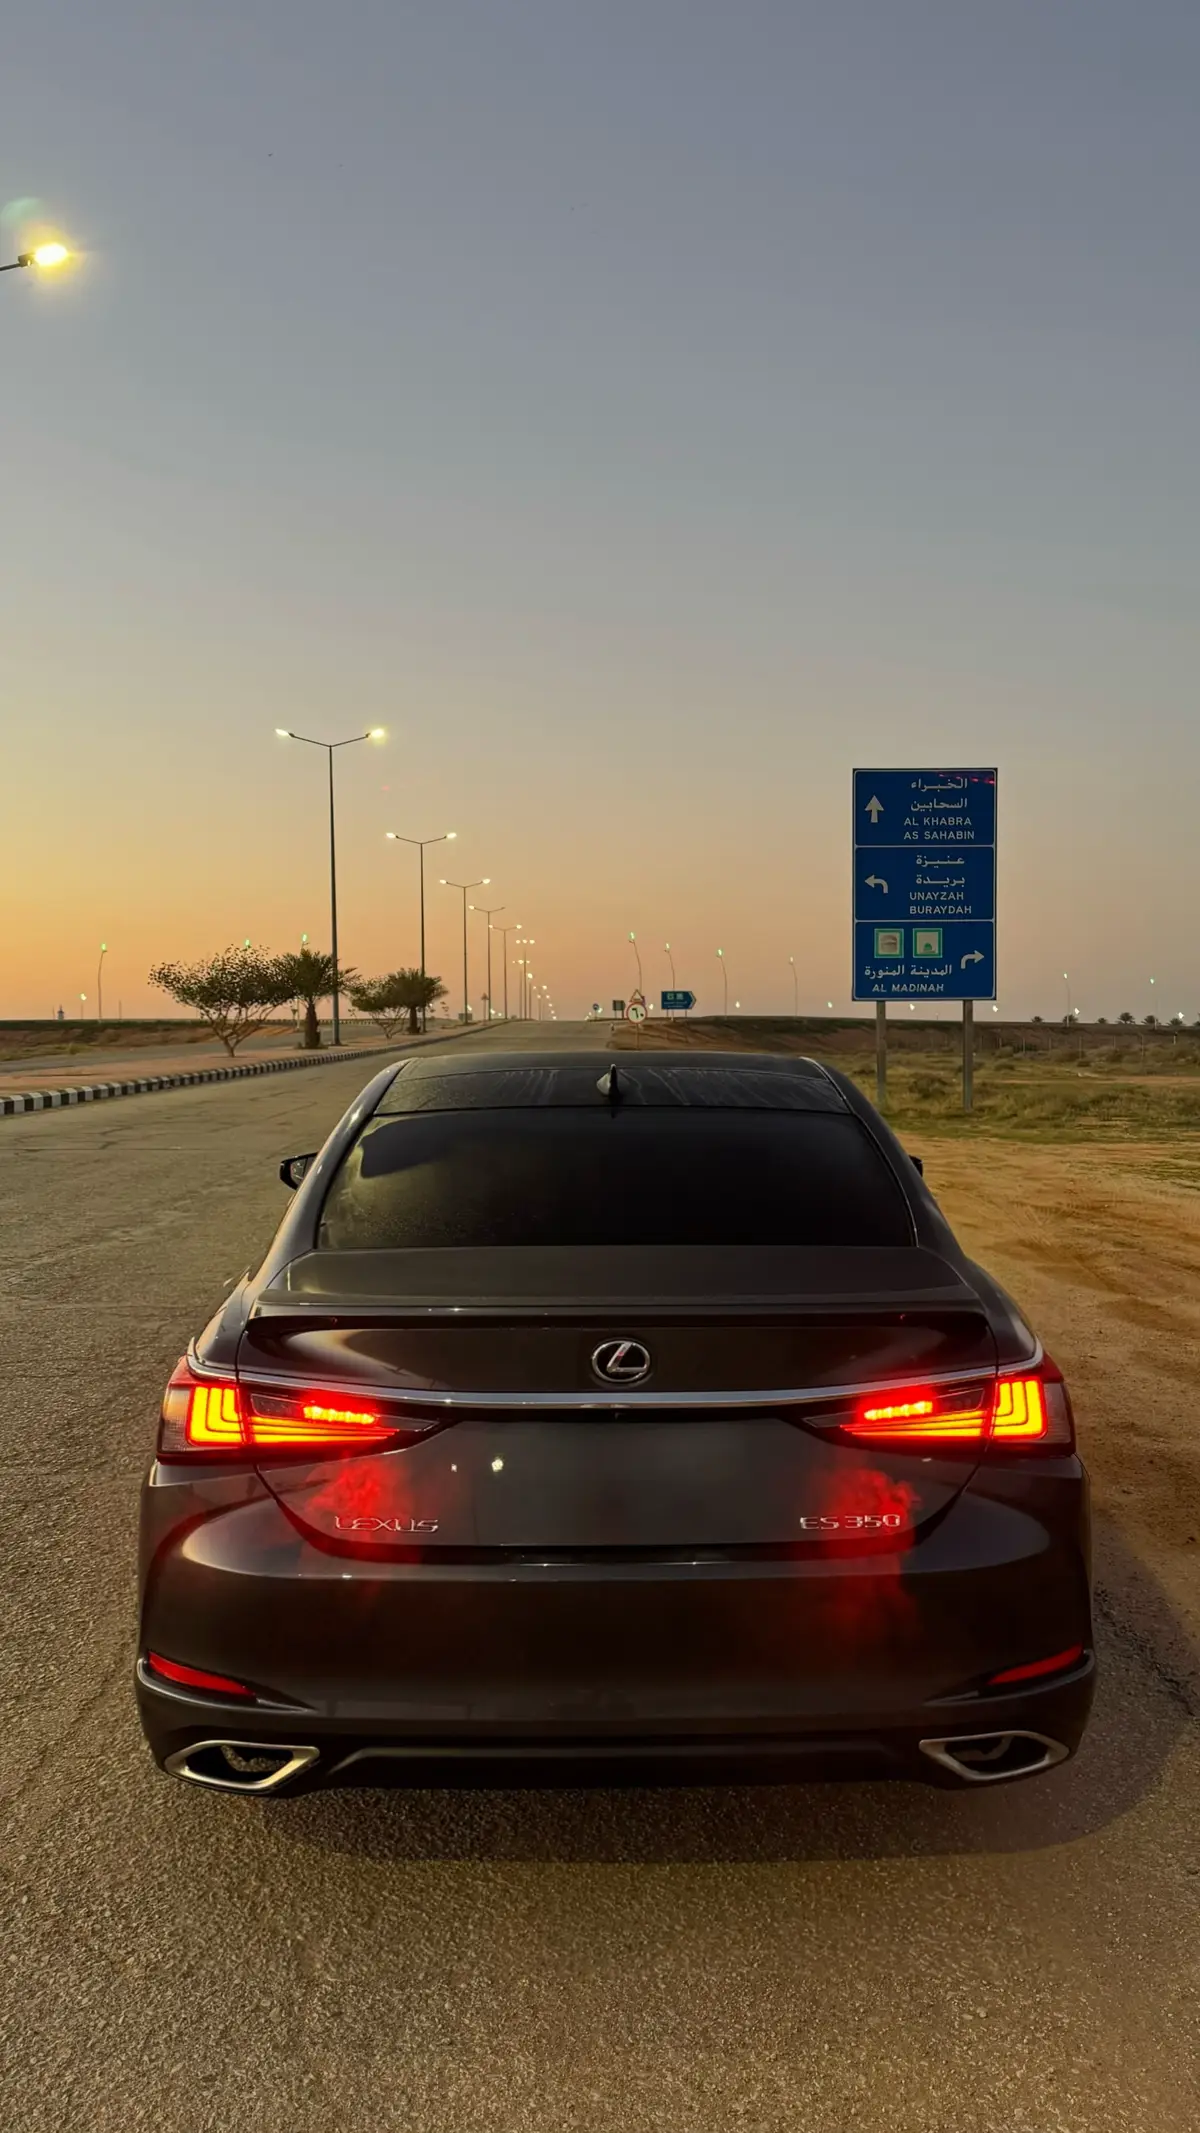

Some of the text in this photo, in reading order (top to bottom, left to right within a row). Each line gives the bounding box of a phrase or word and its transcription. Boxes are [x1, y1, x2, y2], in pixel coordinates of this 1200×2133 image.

[911, 778, 968, 792] الخبراء
[911, 798, 968, 812] السحابين
[903, 817, 972, 826] AL KHABRA
[903, 831, 975, 840] AS SAHABIN
[916, 855, 965, 868] عنيزة
[916, 874, 966, 888] بريدة
[909, 892, 964, 901] UNAYZAH
[909, 905, 972, 914] BURAYDAH
[864, 964, 953, 979] المدينة المنورة
[872, 983, 944, 992] AL MADINAH
[334, 1515, 439, 1533] LEXUS
[800, 1513, 900, 1530] ES 350
